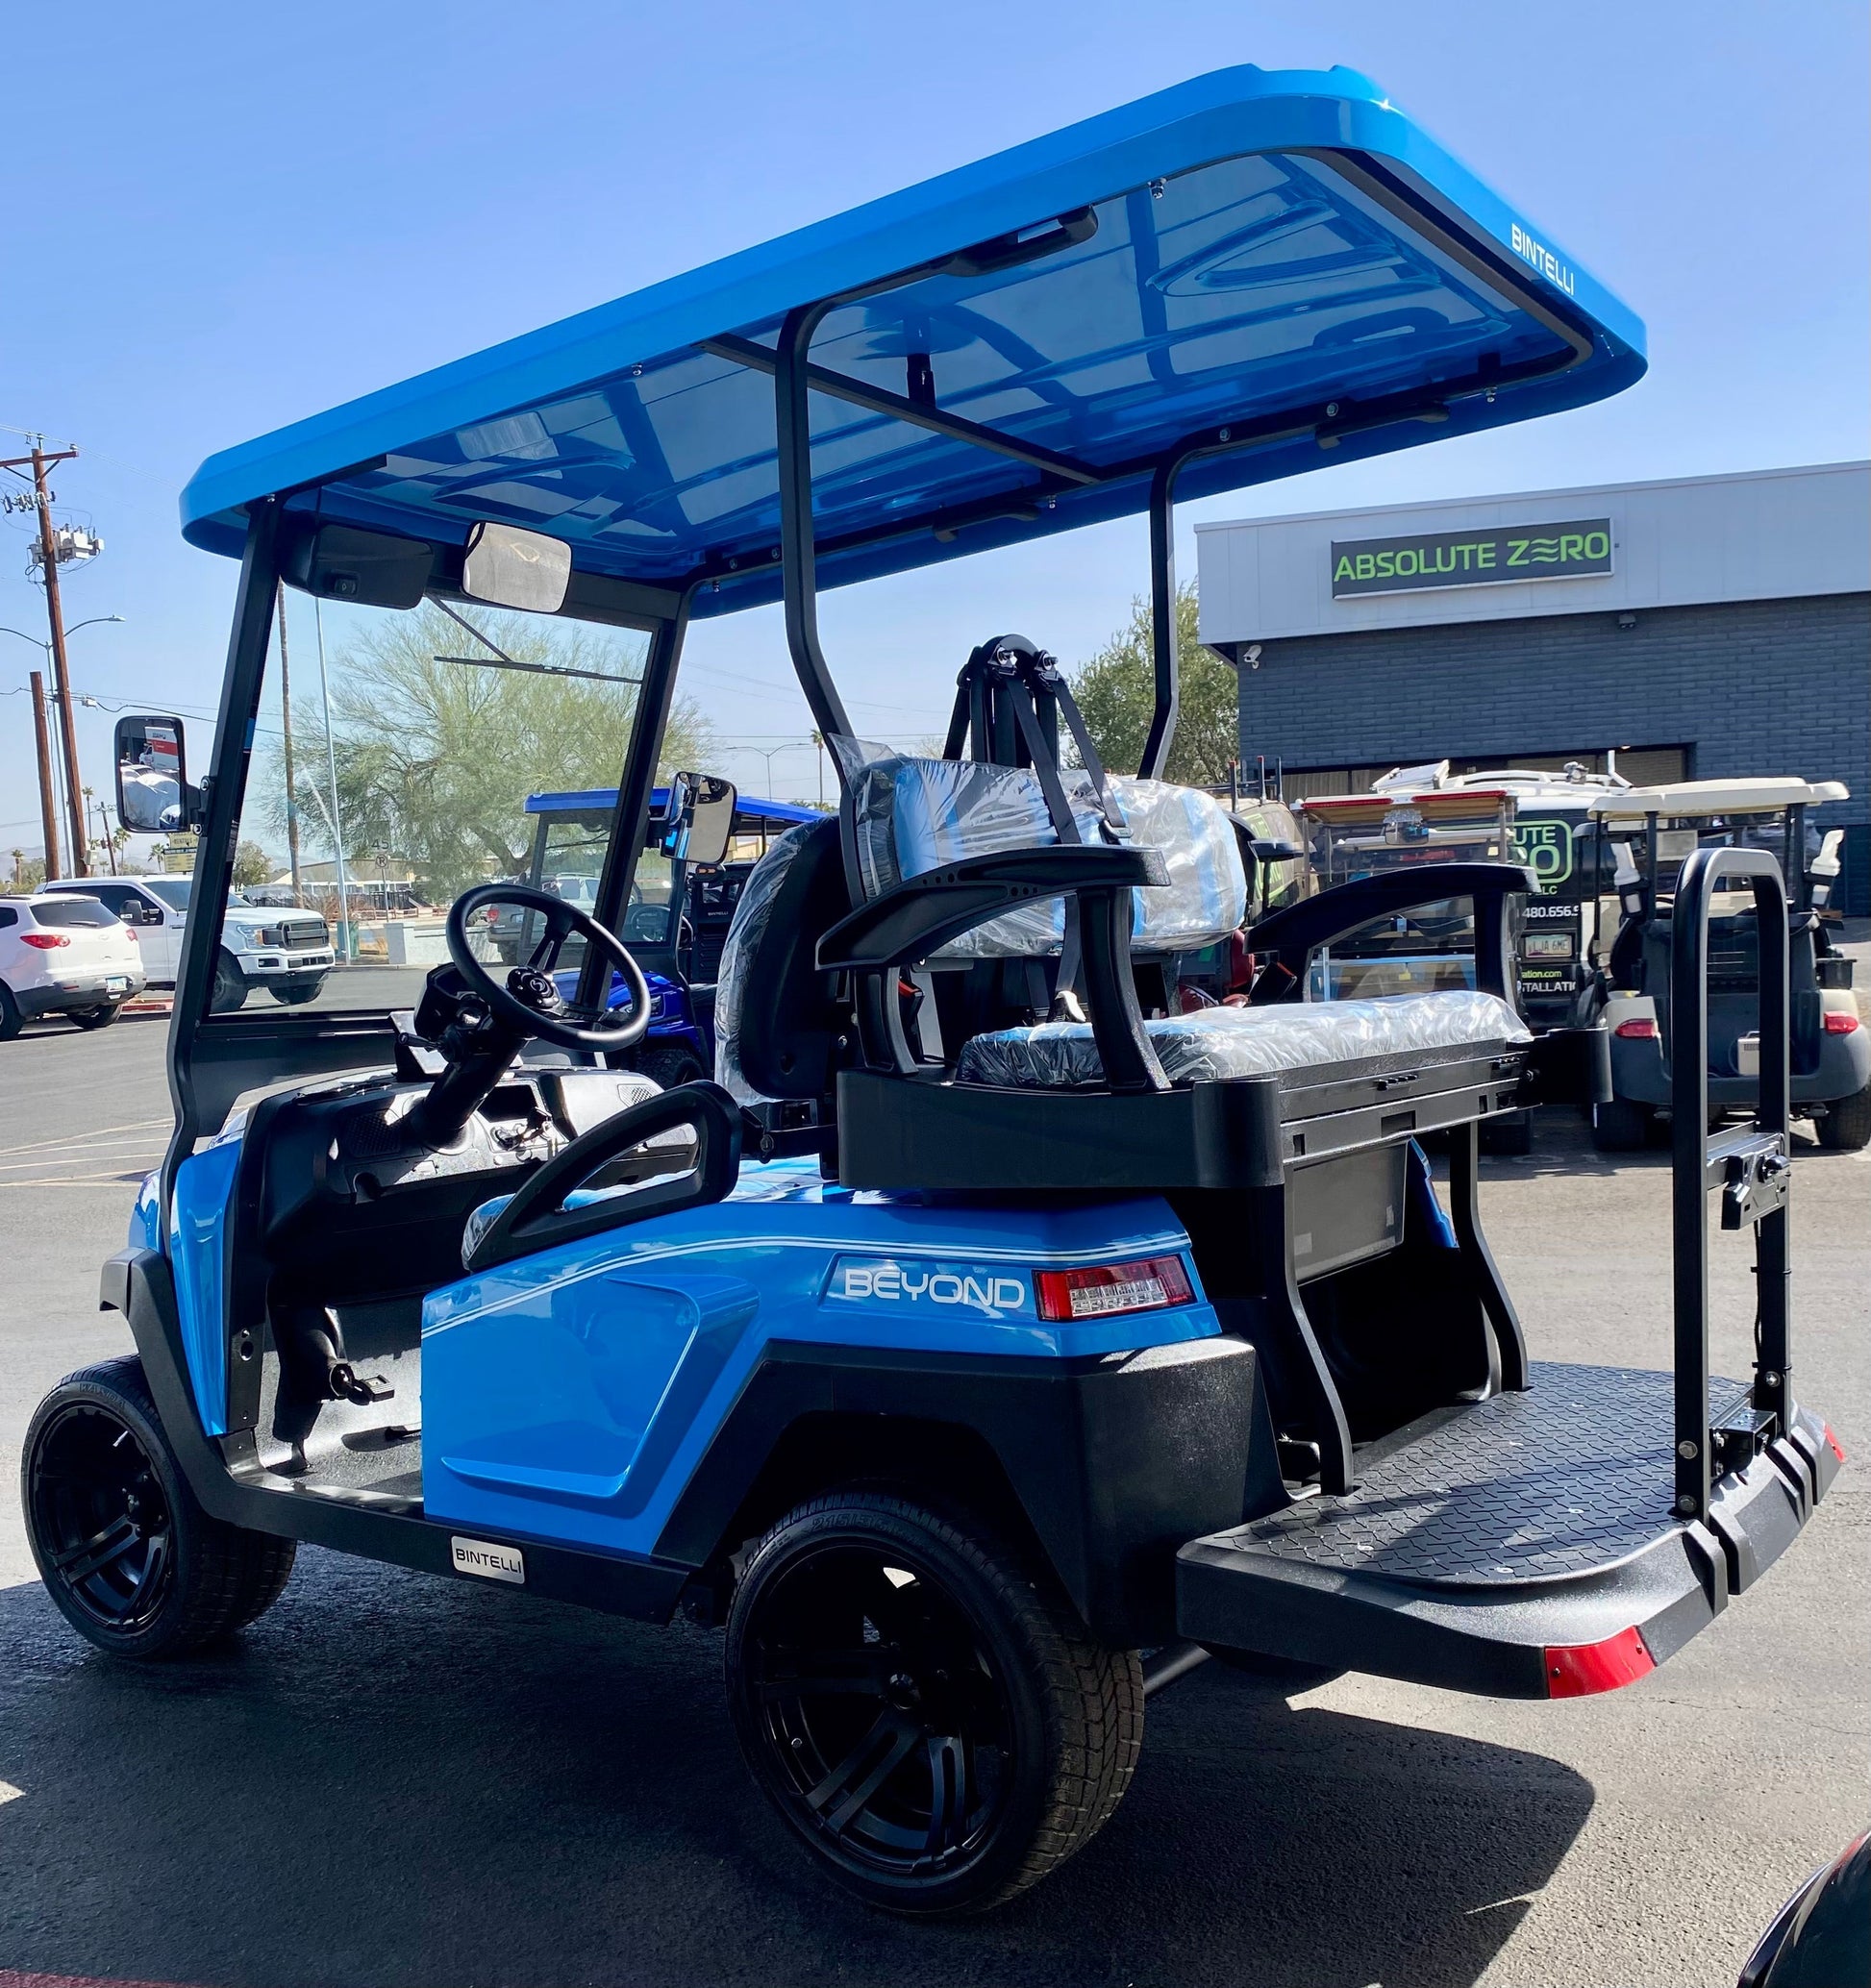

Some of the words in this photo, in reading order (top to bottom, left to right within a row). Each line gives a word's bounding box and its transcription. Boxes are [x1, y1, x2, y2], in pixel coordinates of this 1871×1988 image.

[1511, 222, 1574, 296] BINTELLI
[1334, 542, 1496, 583] ABSOLUTE
[1507, 532, 1609, 567] ZERO
[371, 838, 389, 850] 45
[844, 1268, 1025, 1309] BEYOND
[455, 1548, 522, 1575] BINTELLI
